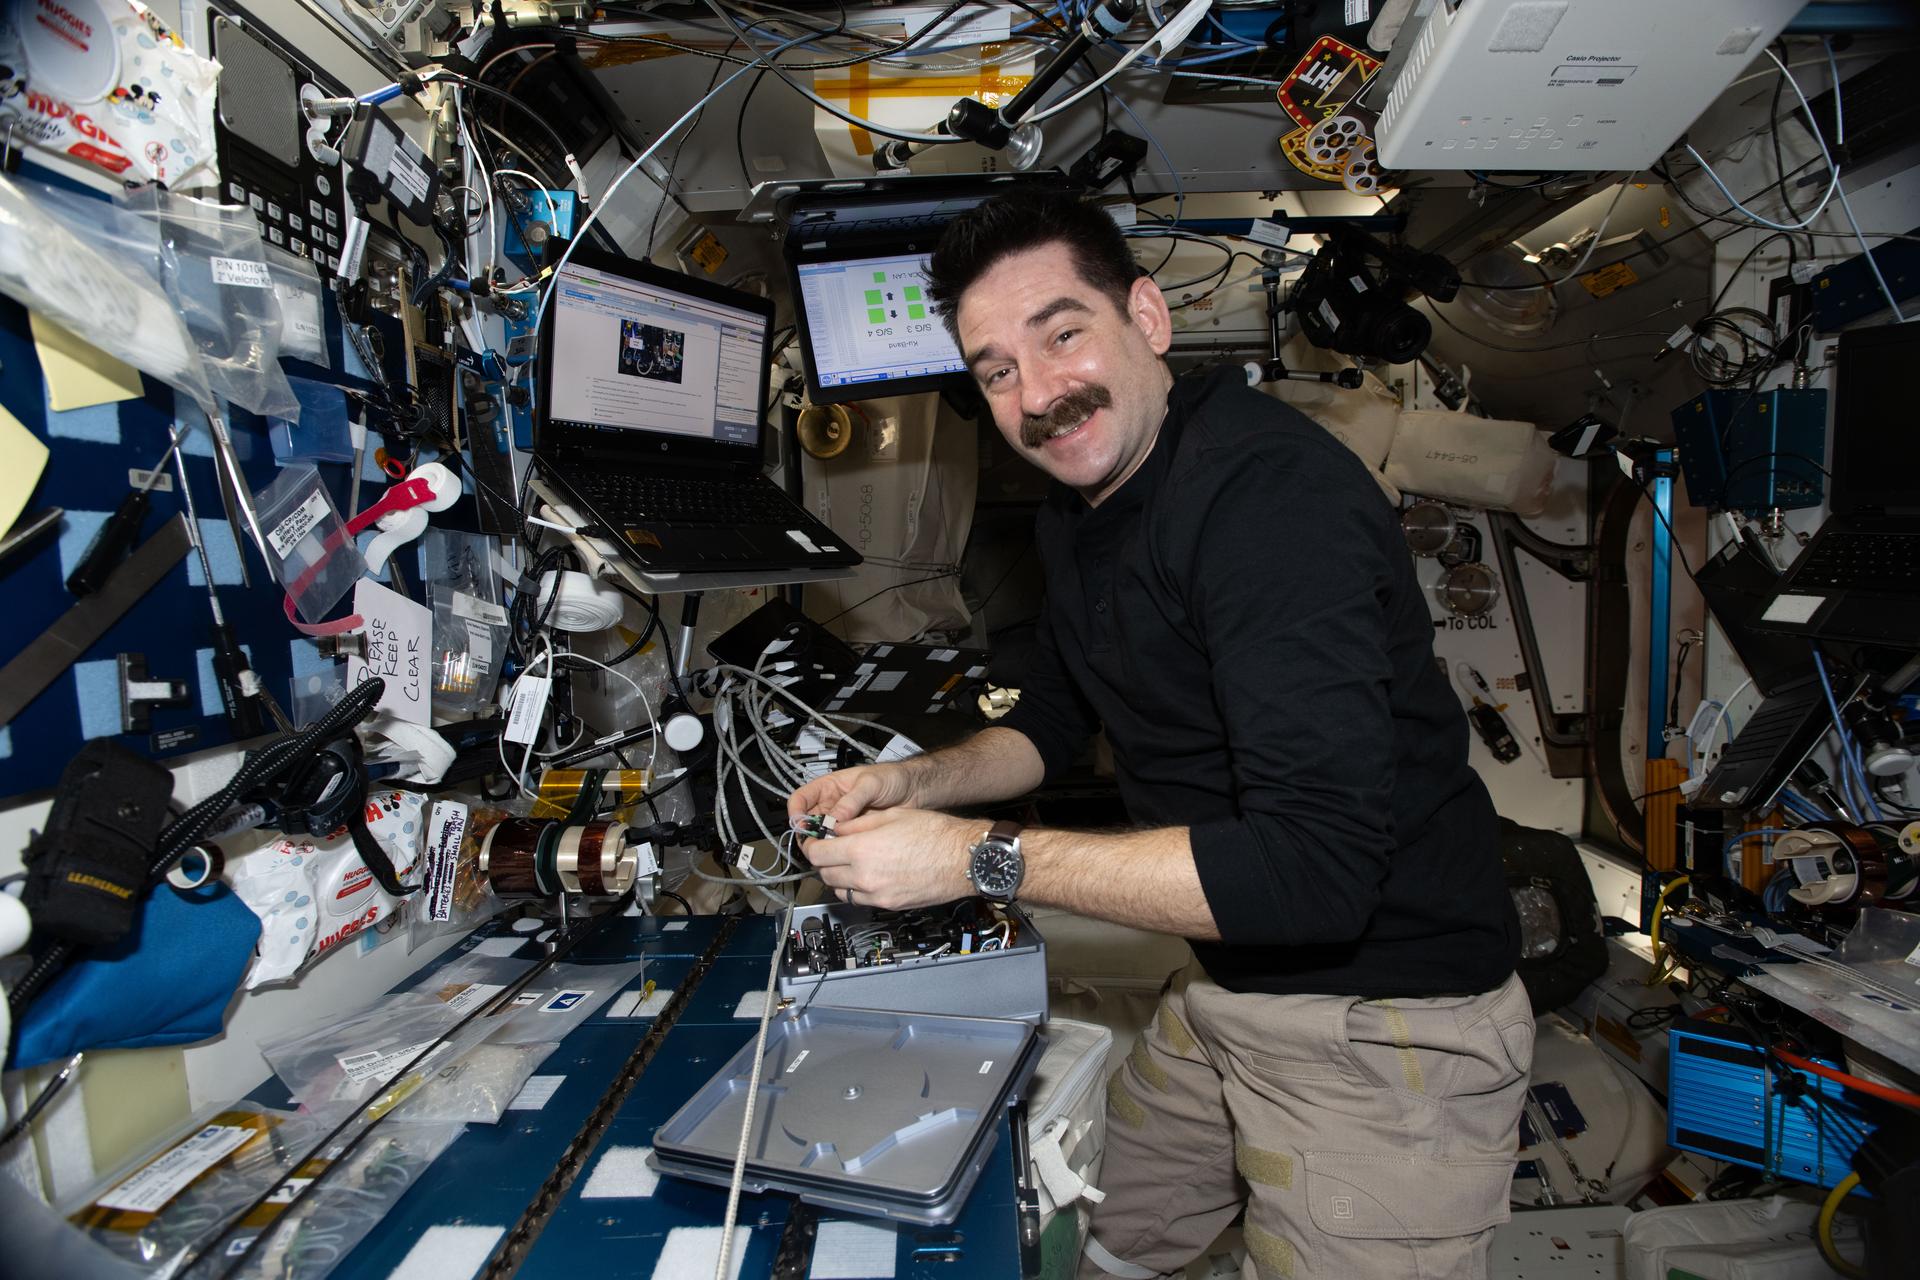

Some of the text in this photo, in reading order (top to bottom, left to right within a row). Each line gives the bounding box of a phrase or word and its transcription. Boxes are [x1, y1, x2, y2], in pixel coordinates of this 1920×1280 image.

[216, 260, 232, 270] P/N
[228, 272, 260, 284] Velcro
[906, 326, 912, 334] 3
[1448, 615, 1497, 630] To COL
[382, 631, 399, 676] KEEP
[404, 636, 420, 702] CLEAR
[450, 836, 461, 860] SMALL
[68, 871, 133, 899] LEATHERMAN
